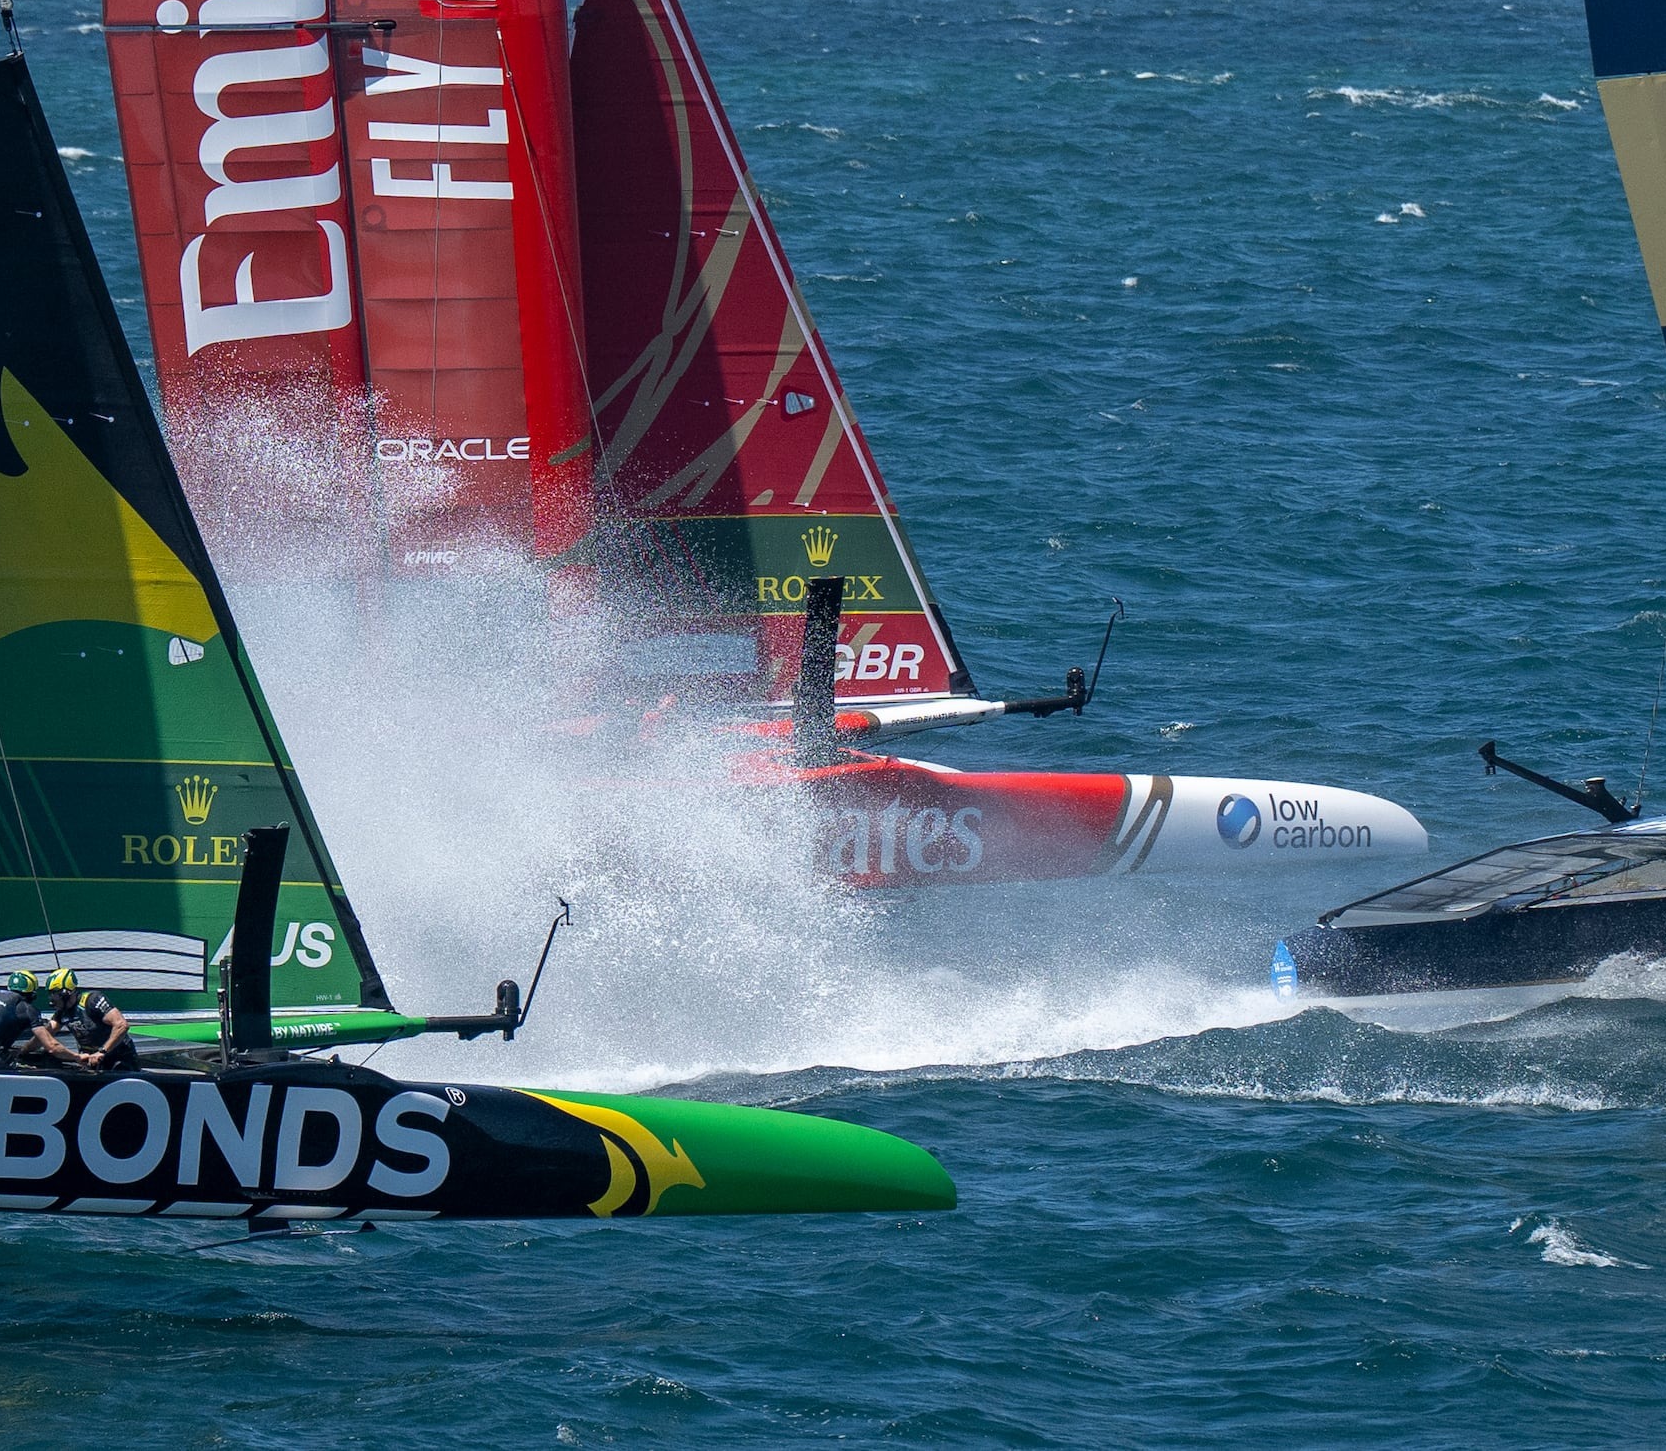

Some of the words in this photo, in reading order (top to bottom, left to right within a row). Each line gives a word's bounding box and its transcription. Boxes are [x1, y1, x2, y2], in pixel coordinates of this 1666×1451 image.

[363, 47, 515, 200] FLY
[375, 436, 531, 461] ORACLE
[755, 574, 884, 602] ROEX
[833, 644, 925, 681] GBR
[1269, 793, 1318, 822] low
[1273, 819, 1372, 849] carbon
[121, 835, 245, 866] ROLE
